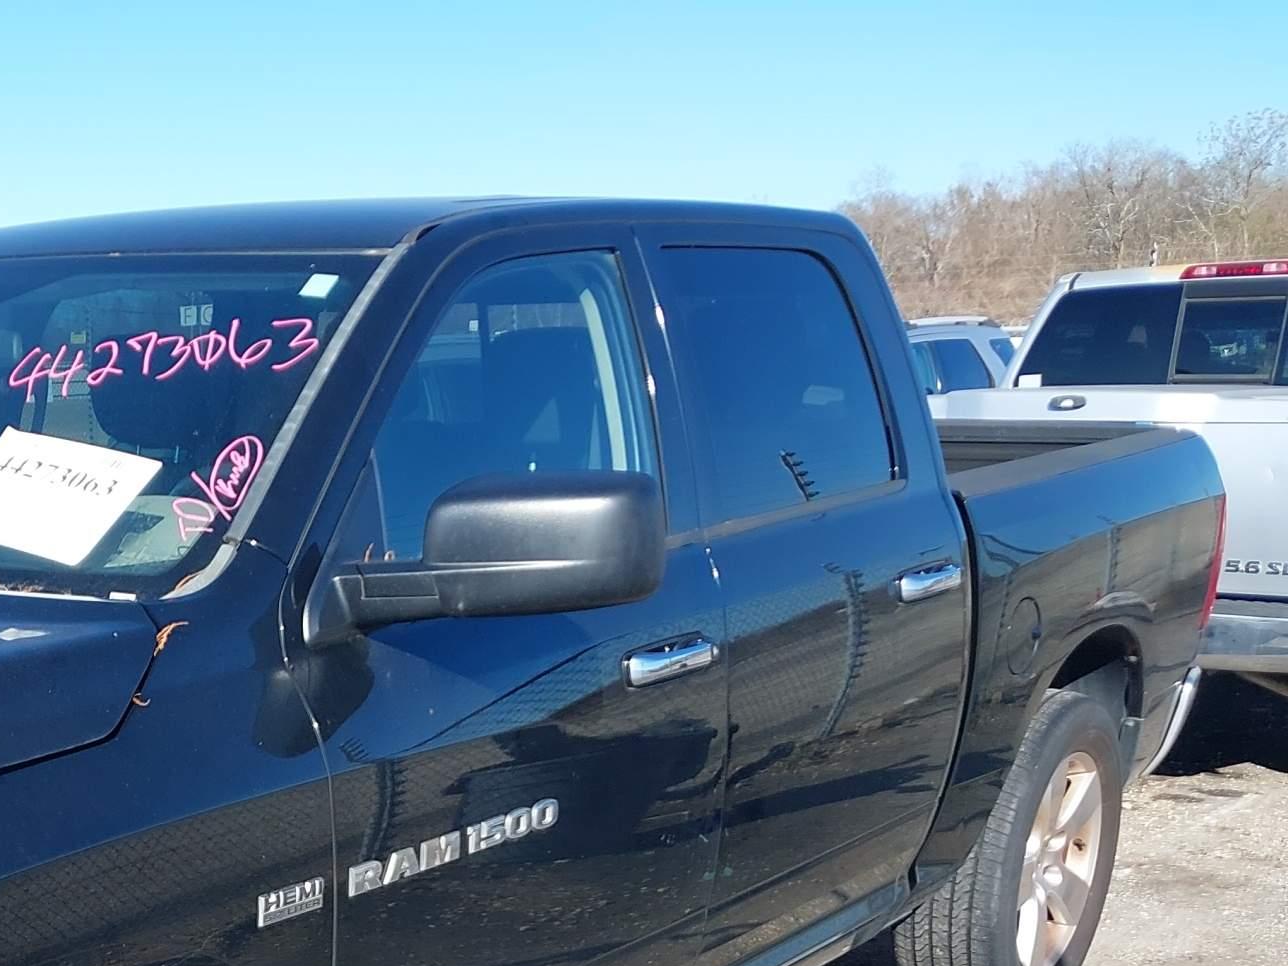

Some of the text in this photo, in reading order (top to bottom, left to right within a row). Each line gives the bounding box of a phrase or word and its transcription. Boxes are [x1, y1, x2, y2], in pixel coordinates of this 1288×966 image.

[9, 317, 319, 402] 44273063
[1225, 560, 1260, 574] 5.6
[348, 797, 560, 898] RAM 1500
[261, 879, 324, 914] HEMI
